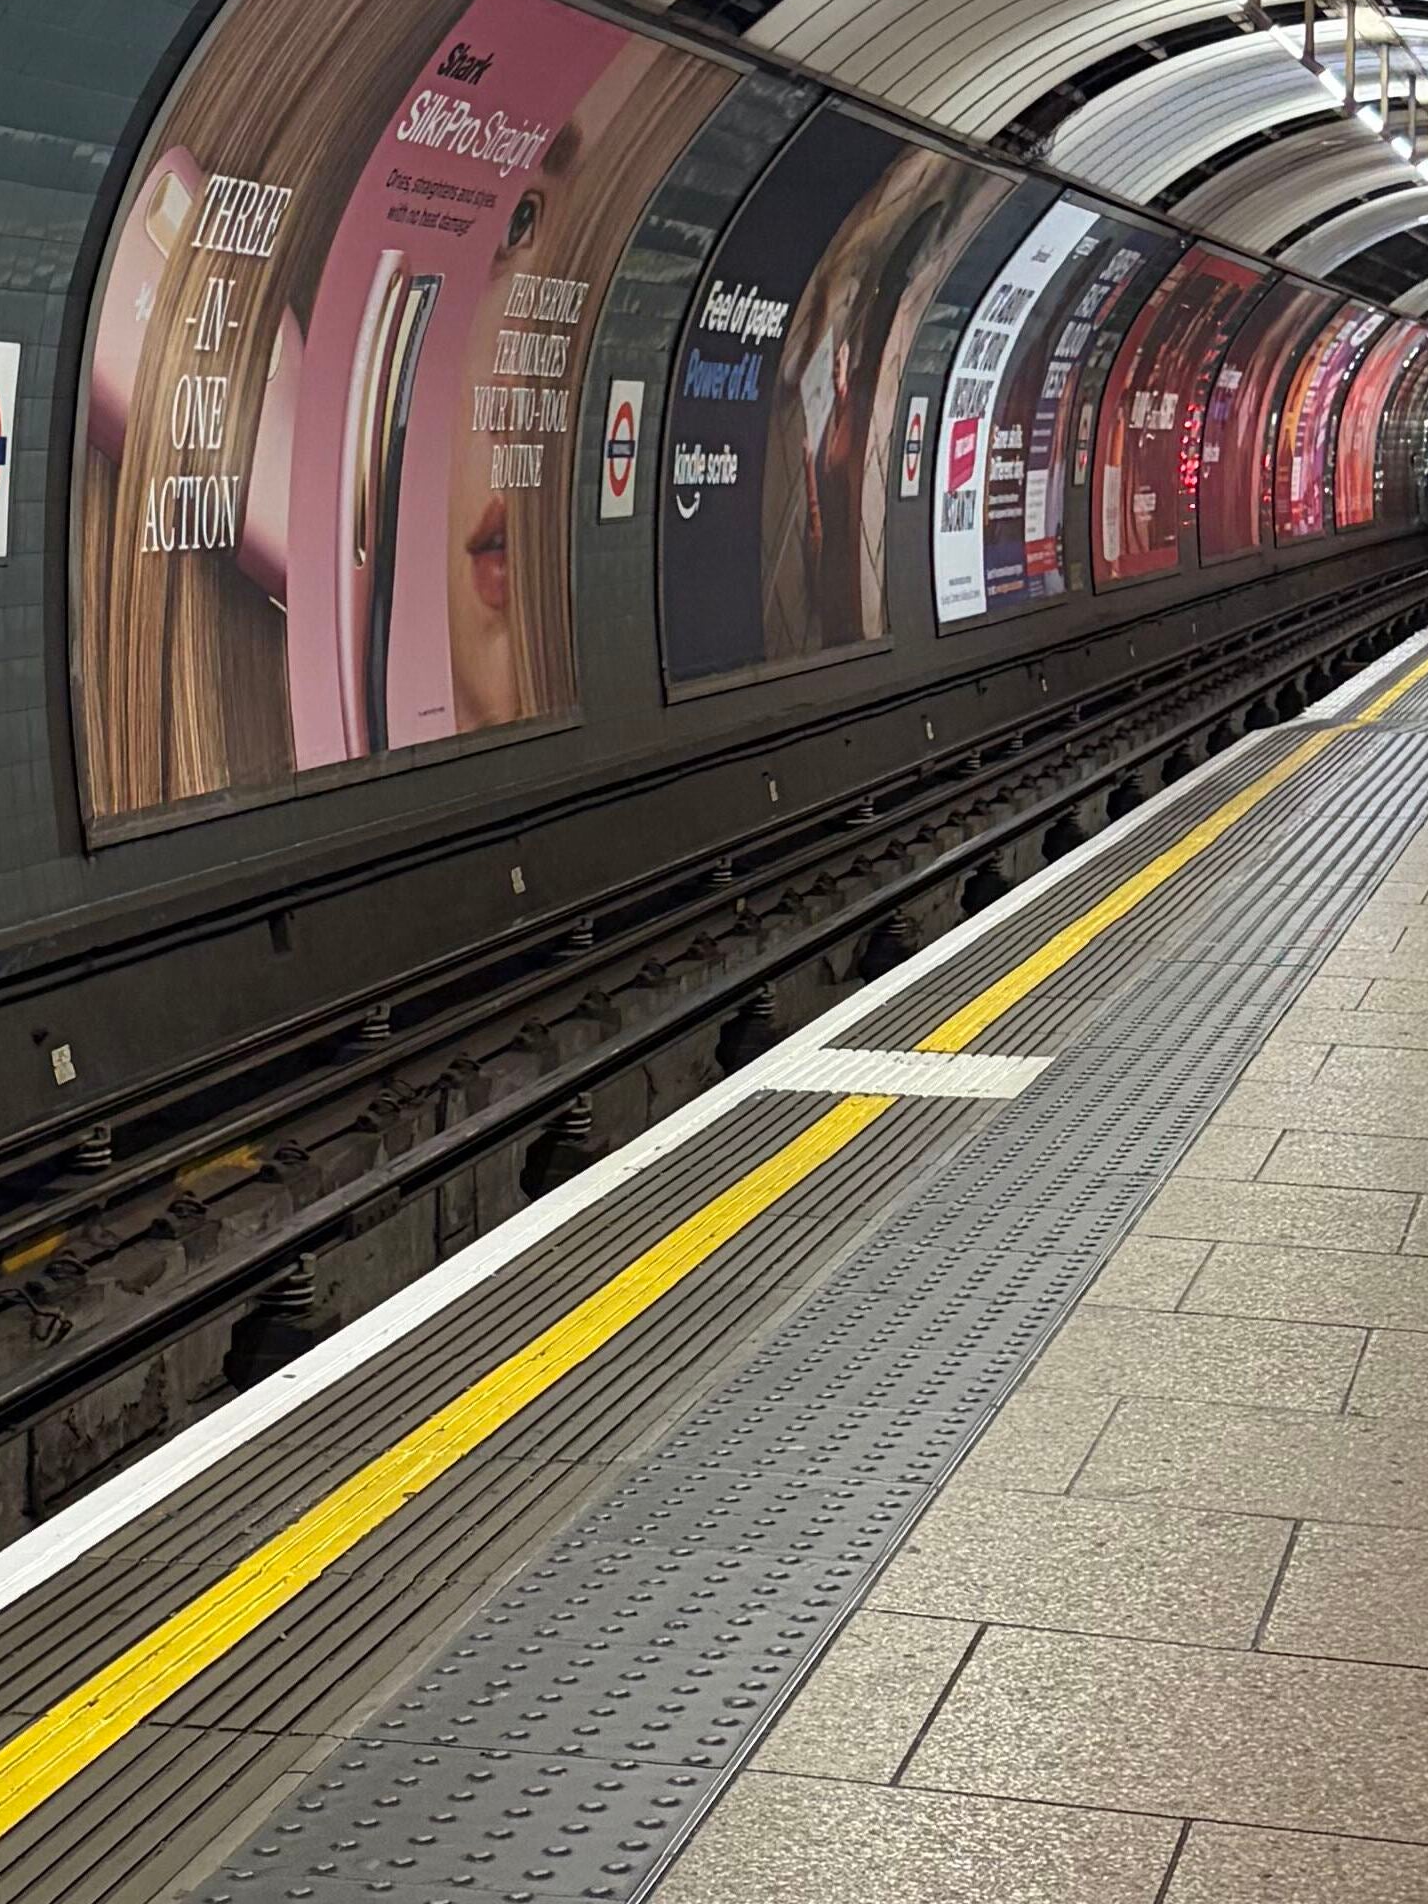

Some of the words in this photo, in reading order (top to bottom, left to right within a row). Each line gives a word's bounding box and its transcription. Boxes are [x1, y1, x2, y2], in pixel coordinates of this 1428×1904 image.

[437, 42, 494, 85] Shark
[397, 90, 481, 155] SilkiPro
[472, 111, 550, 178] Straight
[191, 174, 293, 258] THREE
[186, 277, 238, 352] -IN-
[504, 273, 541, 319] THIS
[533, 277, 589, 324] SERVICE
[699, 280, 742, 331] Feel
[730, 285, 758, 333] of
[741, 299, 789, 345] paper.
[493, 330, 571, 378] TERMINATES
[684, 348, 731, 400] Power
[728, 352, 750, 400] of
[172, 374, 227, 450] ONE
[472, 386, 509, 432] YOUR
[509, 388, 569, 432] TWO-TOOL
[491, 444, 544, 489] ROUTINE
[674, 443, 706, 485] kindle
[707, 444, 738, 484] scribe
[141, 475, 239, 553] ACTION
